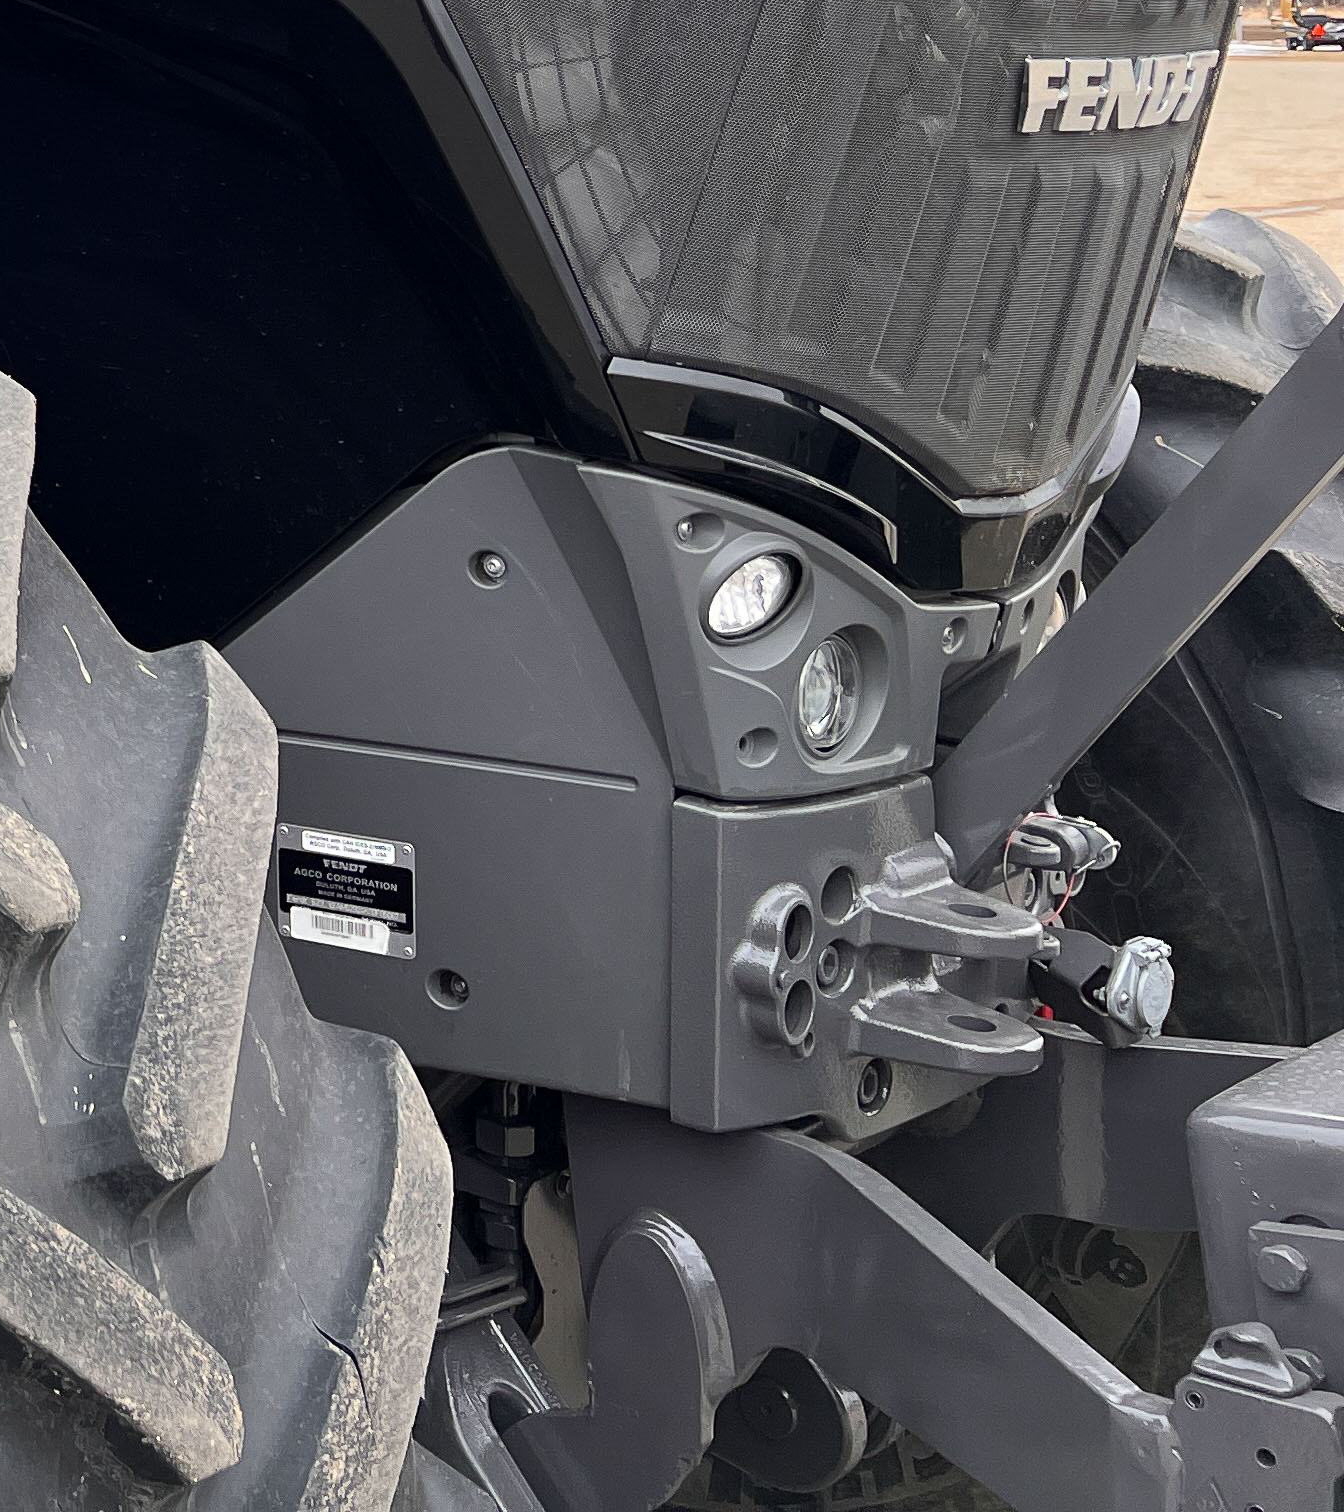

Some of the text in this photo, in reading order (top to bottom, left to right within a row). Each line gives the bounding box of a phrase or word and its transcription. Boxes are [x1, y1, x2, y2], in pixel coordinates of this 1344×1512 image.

[1017, 49, 1220, 133] FENDT
[322, 858, 367, 873] FENDT
[294, 868, 398, 892] AGCO CORPORATION
[360, 888, 376, 896] USA
